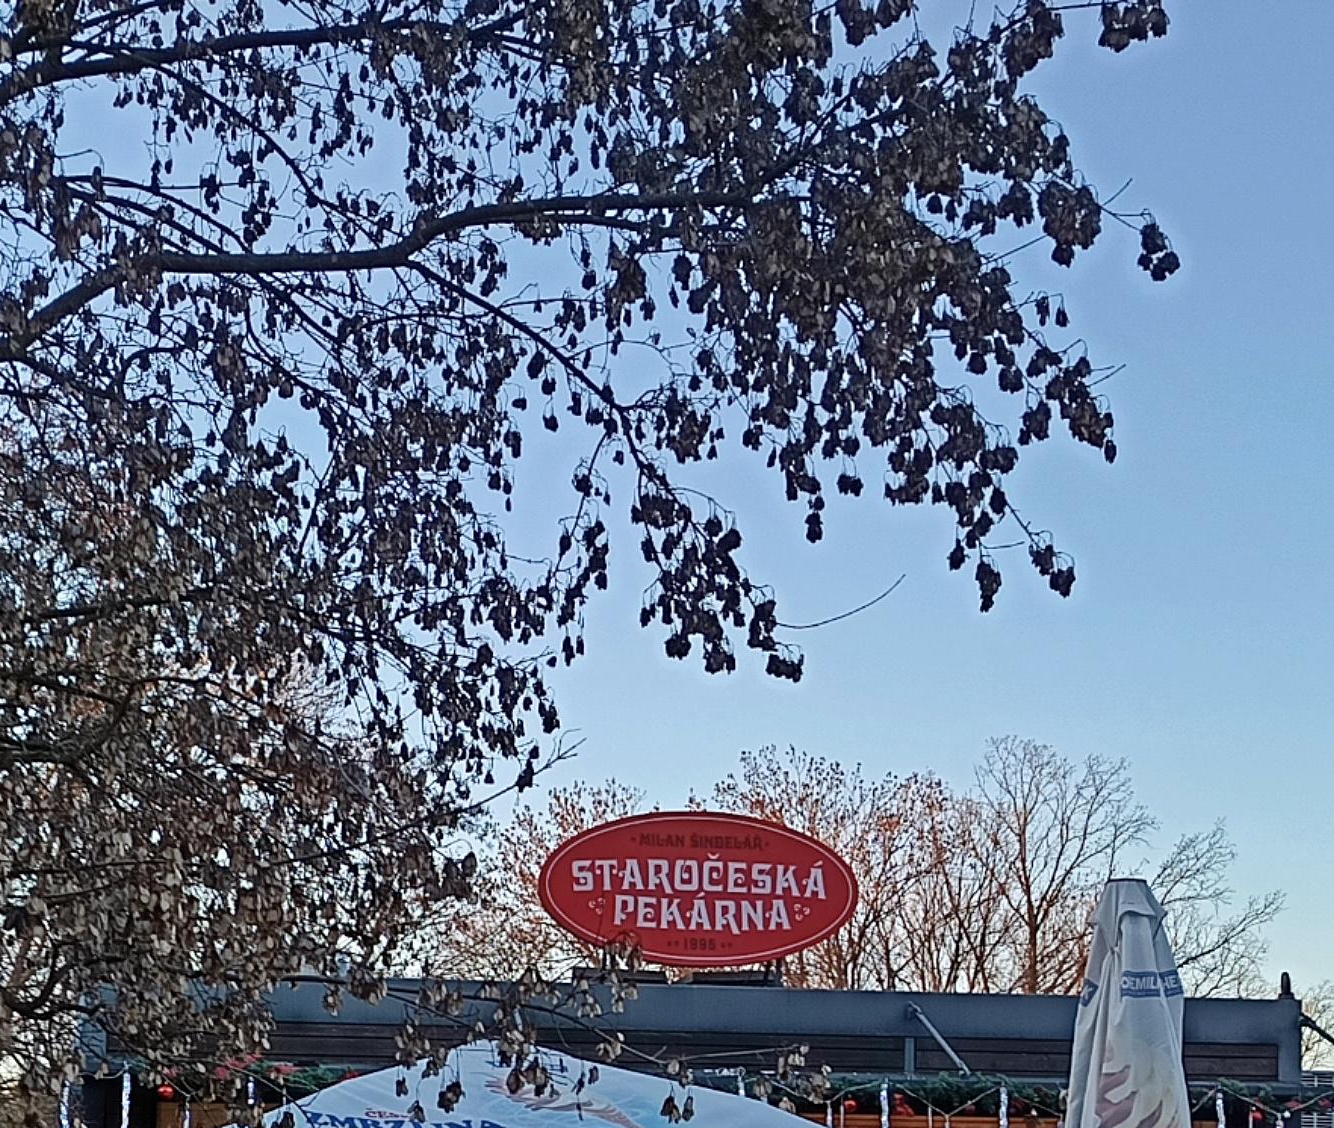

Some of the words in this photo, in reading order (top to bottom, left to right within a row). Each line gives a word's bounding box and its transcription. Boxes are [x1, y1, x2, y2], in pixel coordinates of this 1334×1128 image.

[639, 833, 685, 847] MILAN
[571, 852, 827, 900] STAROČESKÁ
[613, 892, 792, 935] PEKÁRNA
